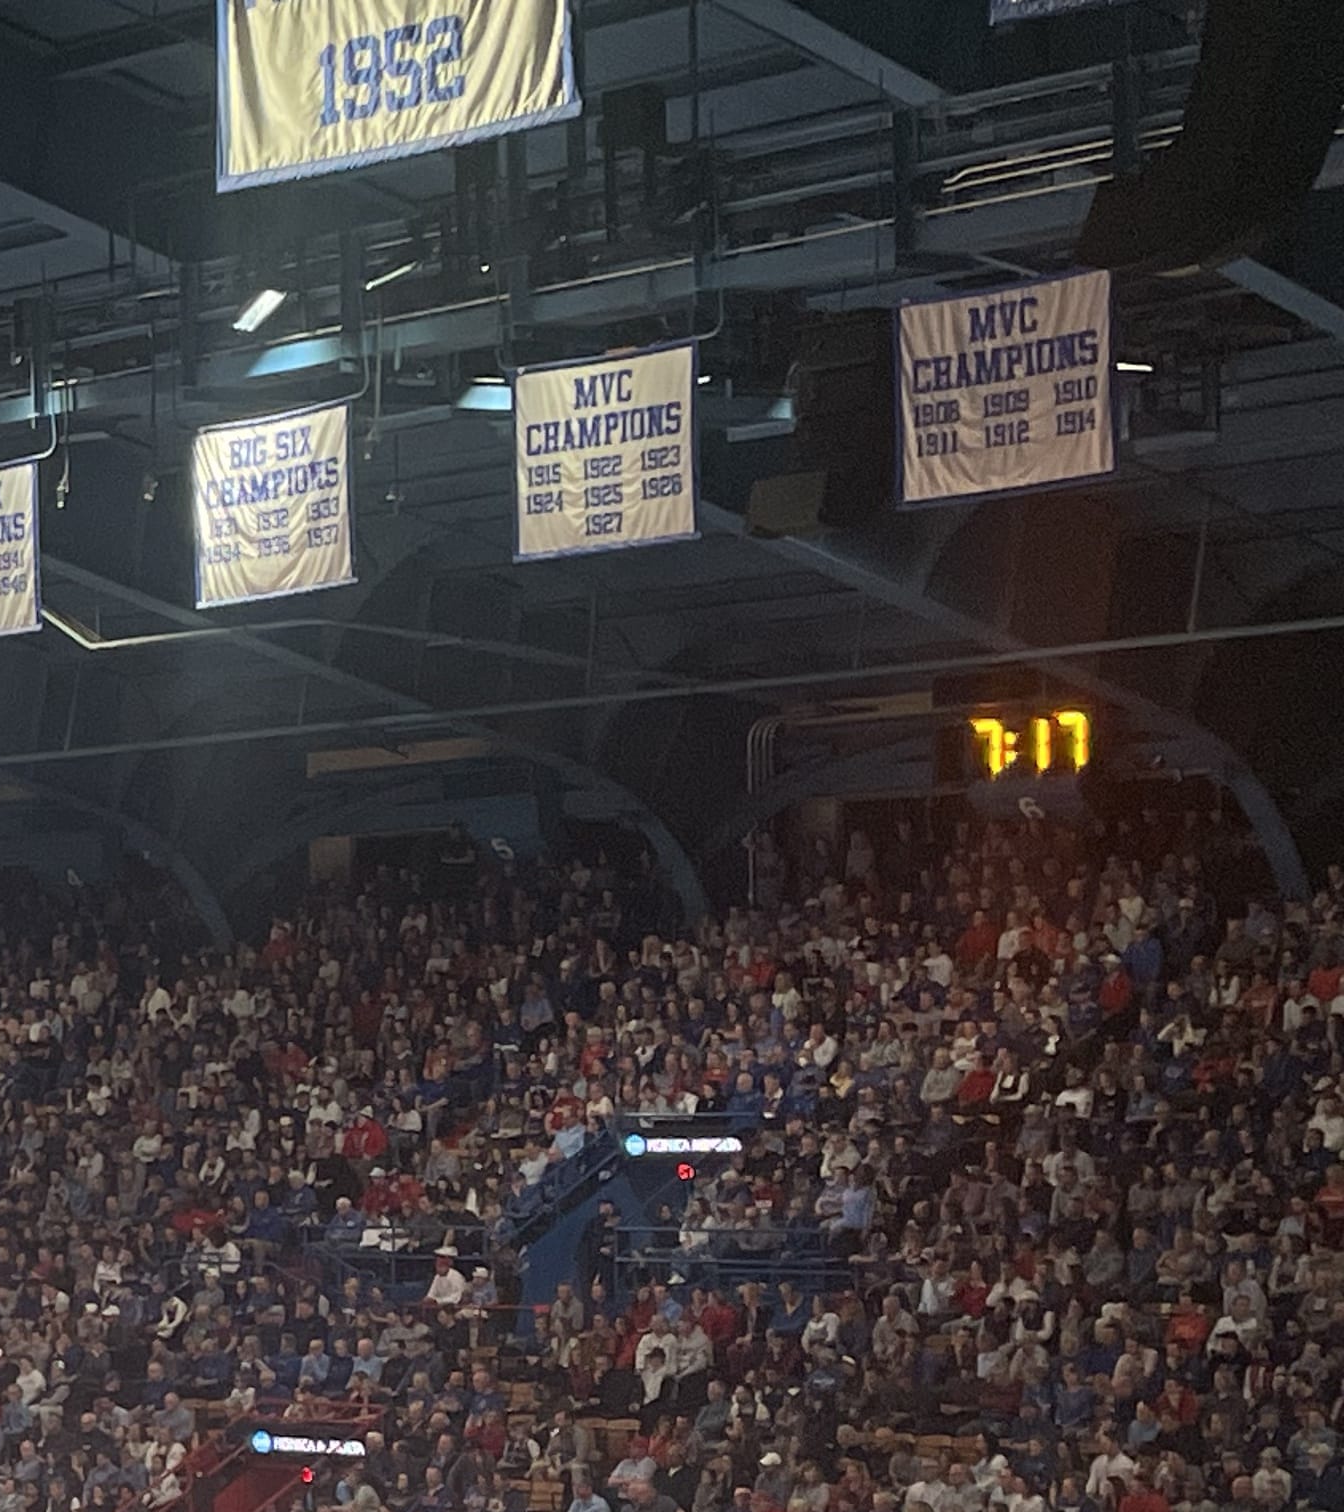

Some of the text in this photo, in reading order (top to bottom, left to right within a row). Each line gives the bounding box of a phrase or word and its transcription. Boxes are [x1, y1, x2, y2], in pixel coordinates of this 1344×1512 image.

[320, 15, 465, 127] 1952
[968, 297, 1039, 343] MVC
[912, 329, 1099, 395] CHAMPIONS
[574, 368, 633, 410] MVC
[913, 376, 1097, 428] 1908 1909 1910
[229, 425, 311, 470] BIG SIX
[526, 401, 682, 457] CHAMPIONS
[917, 409, 1097, 458] 1911 1912 1914
[205, 456, 338, 510] CHAMPIONS
[527, 445, 681, 488] 1915 1922 1923
[526, 482, 624, 515] 1924 1925
[306, 524, 339, 549] 1937
[585, 511, 624, 537] 1927
[969, 711, 1091, 780] 7:17
